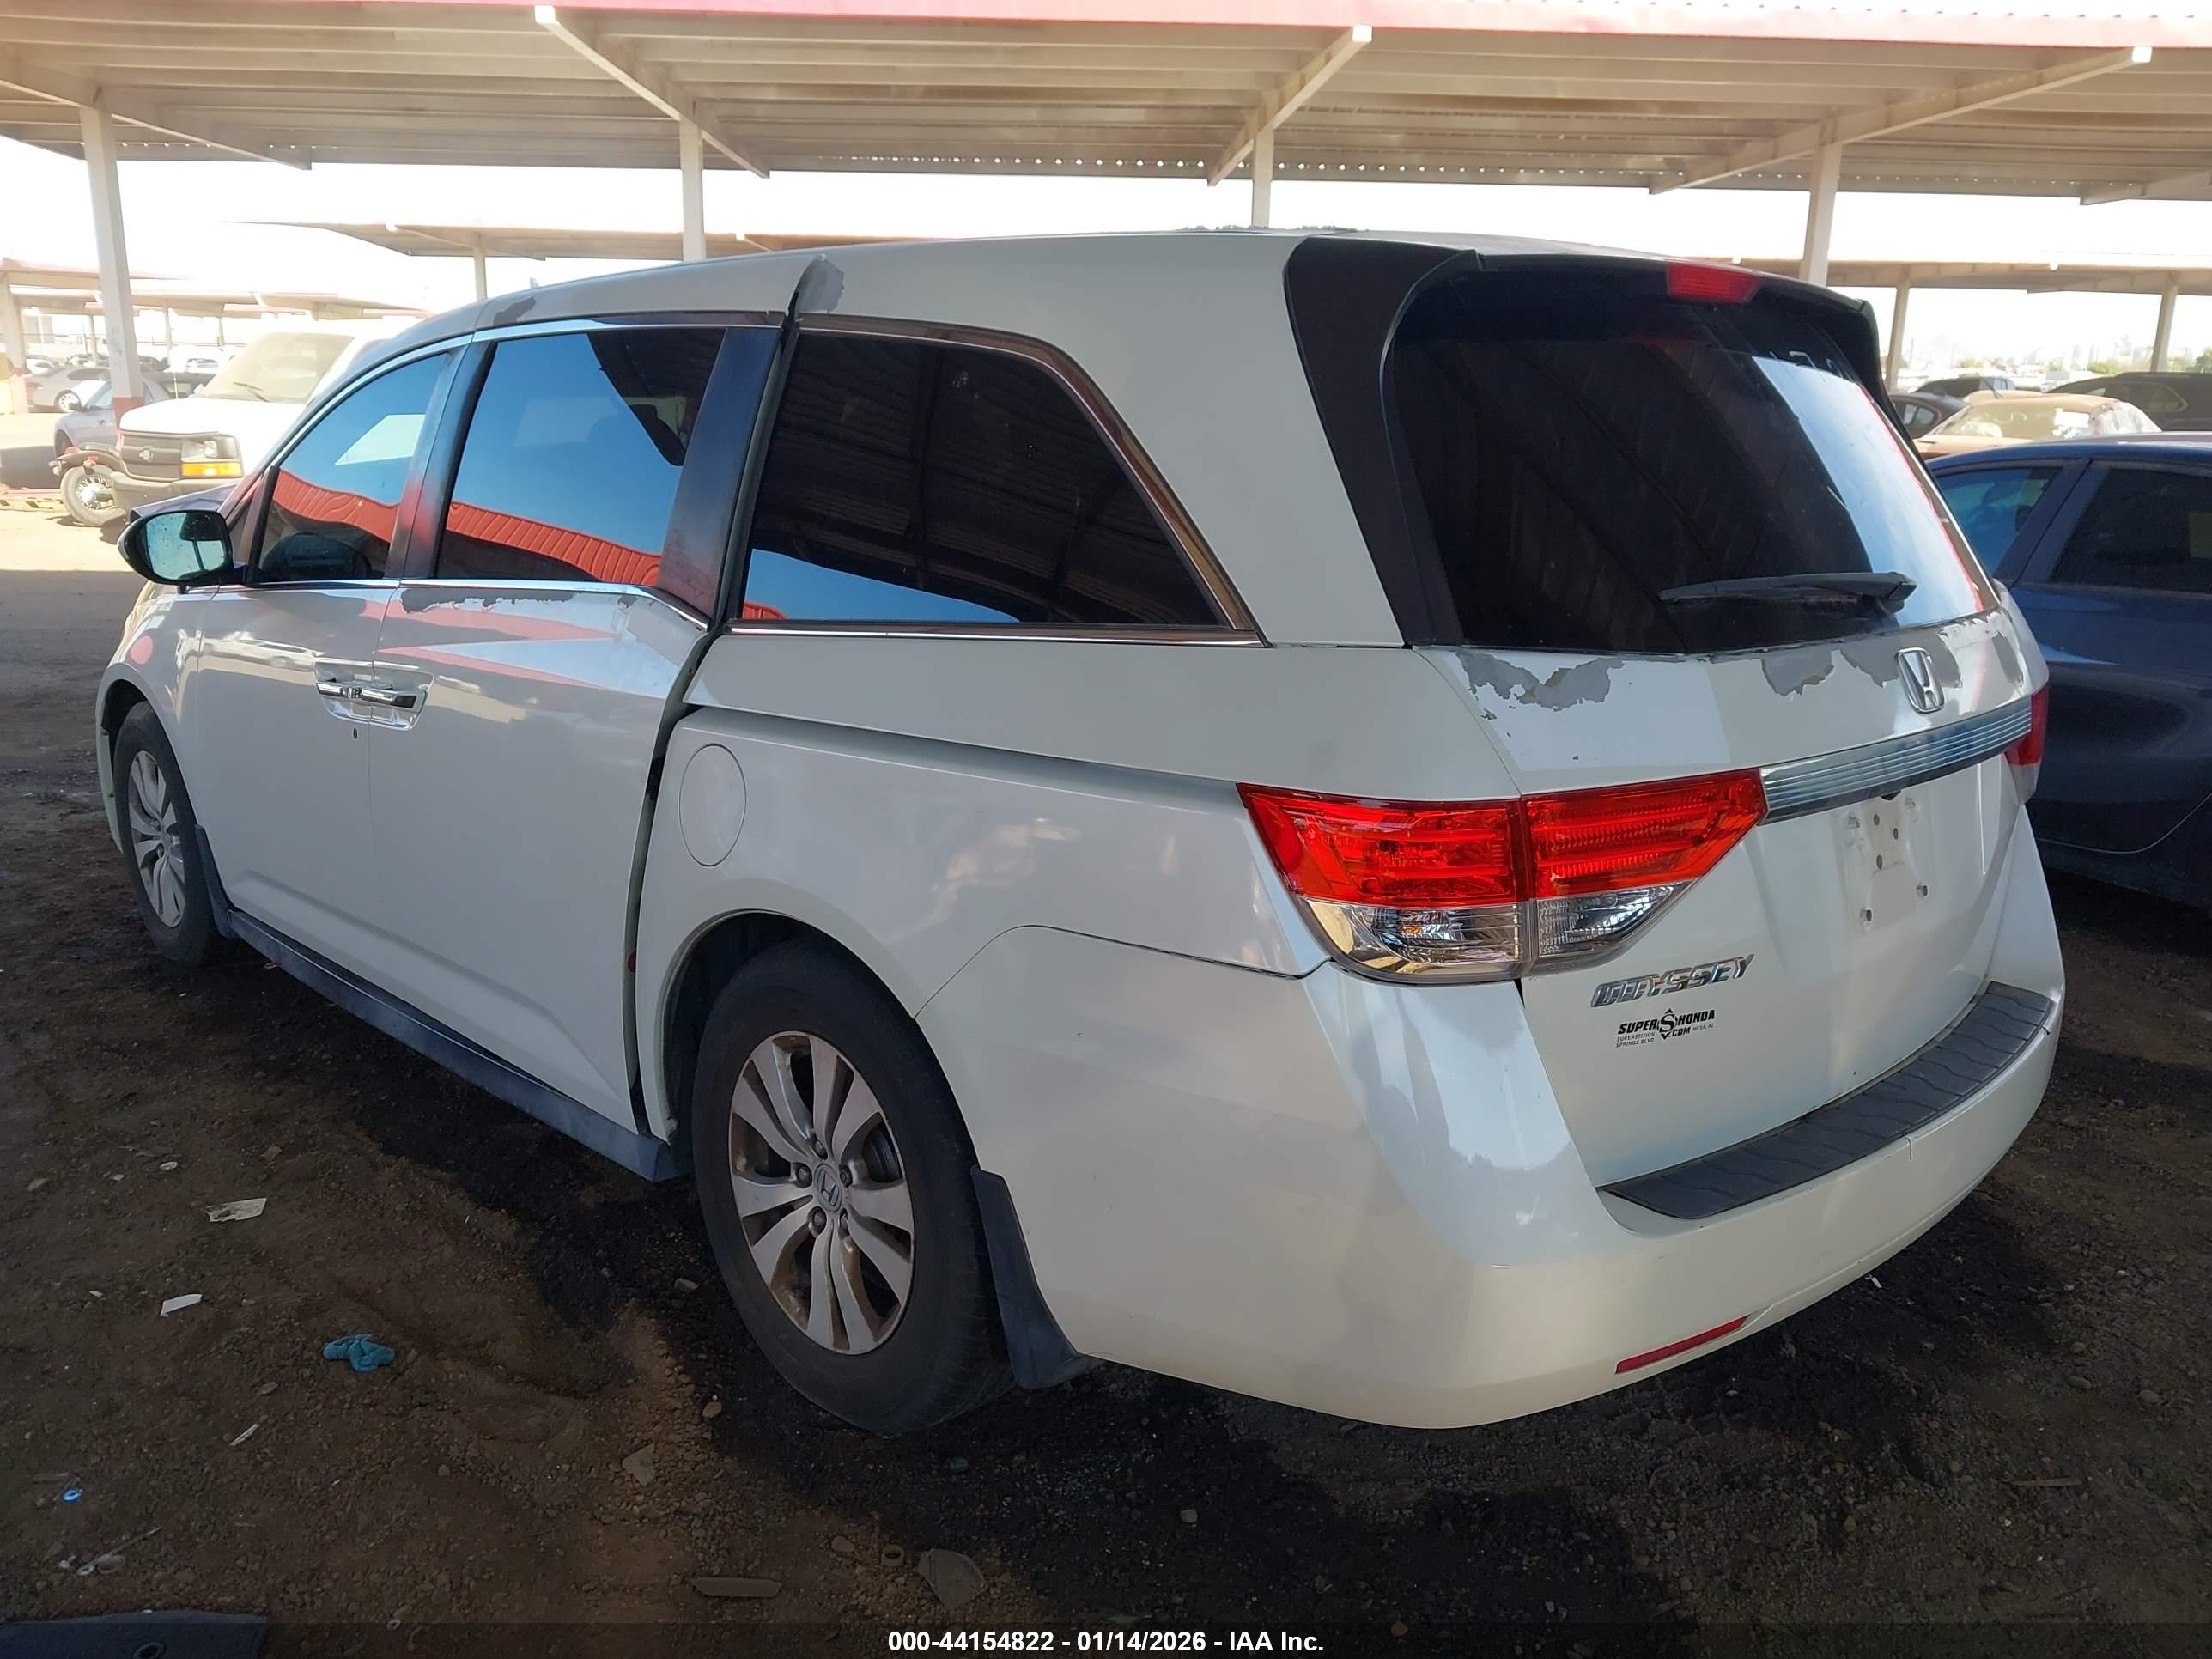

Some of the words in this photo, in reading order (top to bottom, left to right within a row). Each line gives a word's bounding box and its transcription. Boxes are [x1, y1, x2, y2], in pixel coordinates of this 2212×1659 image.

[1618, 1018, 1658, 1035] SUPER
[1678, 1010, 1715, 1025] HONDA
[1616, 1031, 1656, 1042] SUPERSTITION
